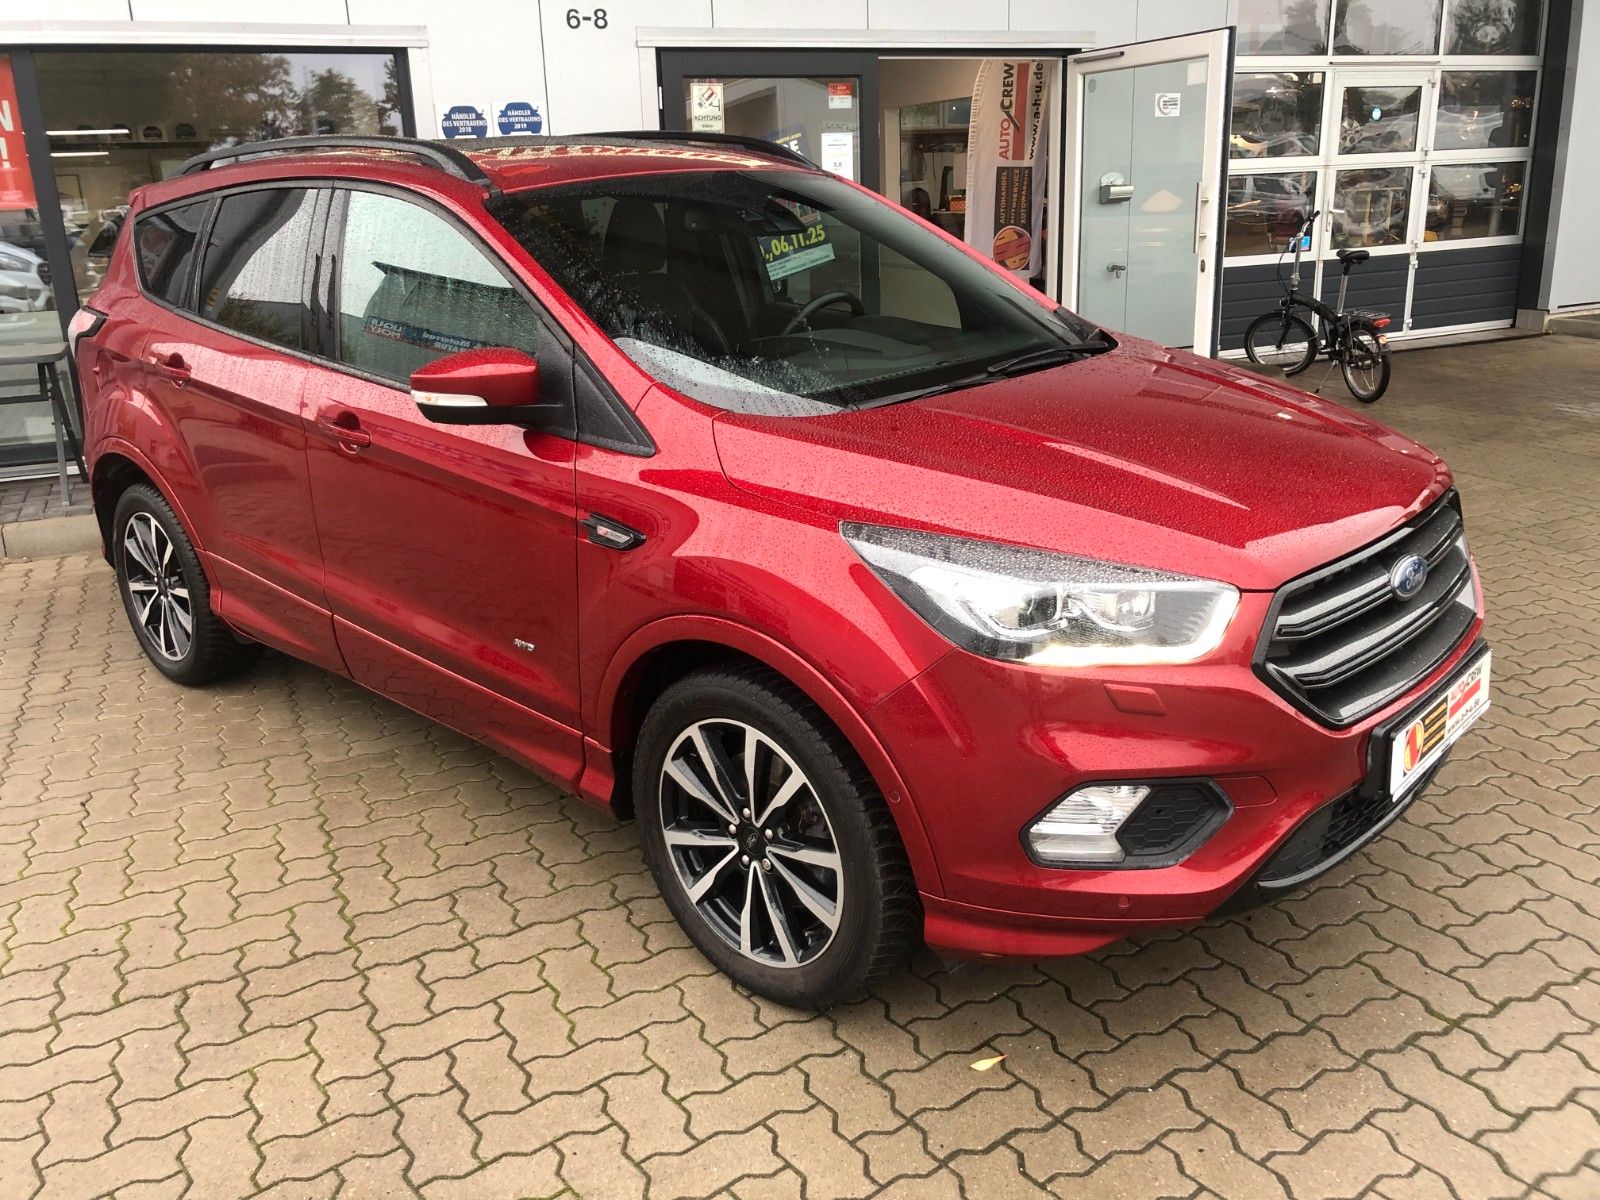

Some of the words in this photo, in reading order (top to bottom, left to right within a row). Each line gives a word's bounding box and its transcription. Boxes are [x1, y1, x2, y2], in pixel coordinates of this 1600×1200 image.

[566, 8, 608, 29] 6-8
[1000, 62, 1015, 111] CREW
[451, 112, 477, 120] HÄNDLER
[453, 119, 487, 127] VERTRAUENS
[1029, 63, 1043, 160] www.a-h-u.de
[999, 118, 1011, 160] AUTO
[1000, 170, 1008, 224] AUTOHANDEL
[1010, 168, 1019, 224] AUTOSERVICE
